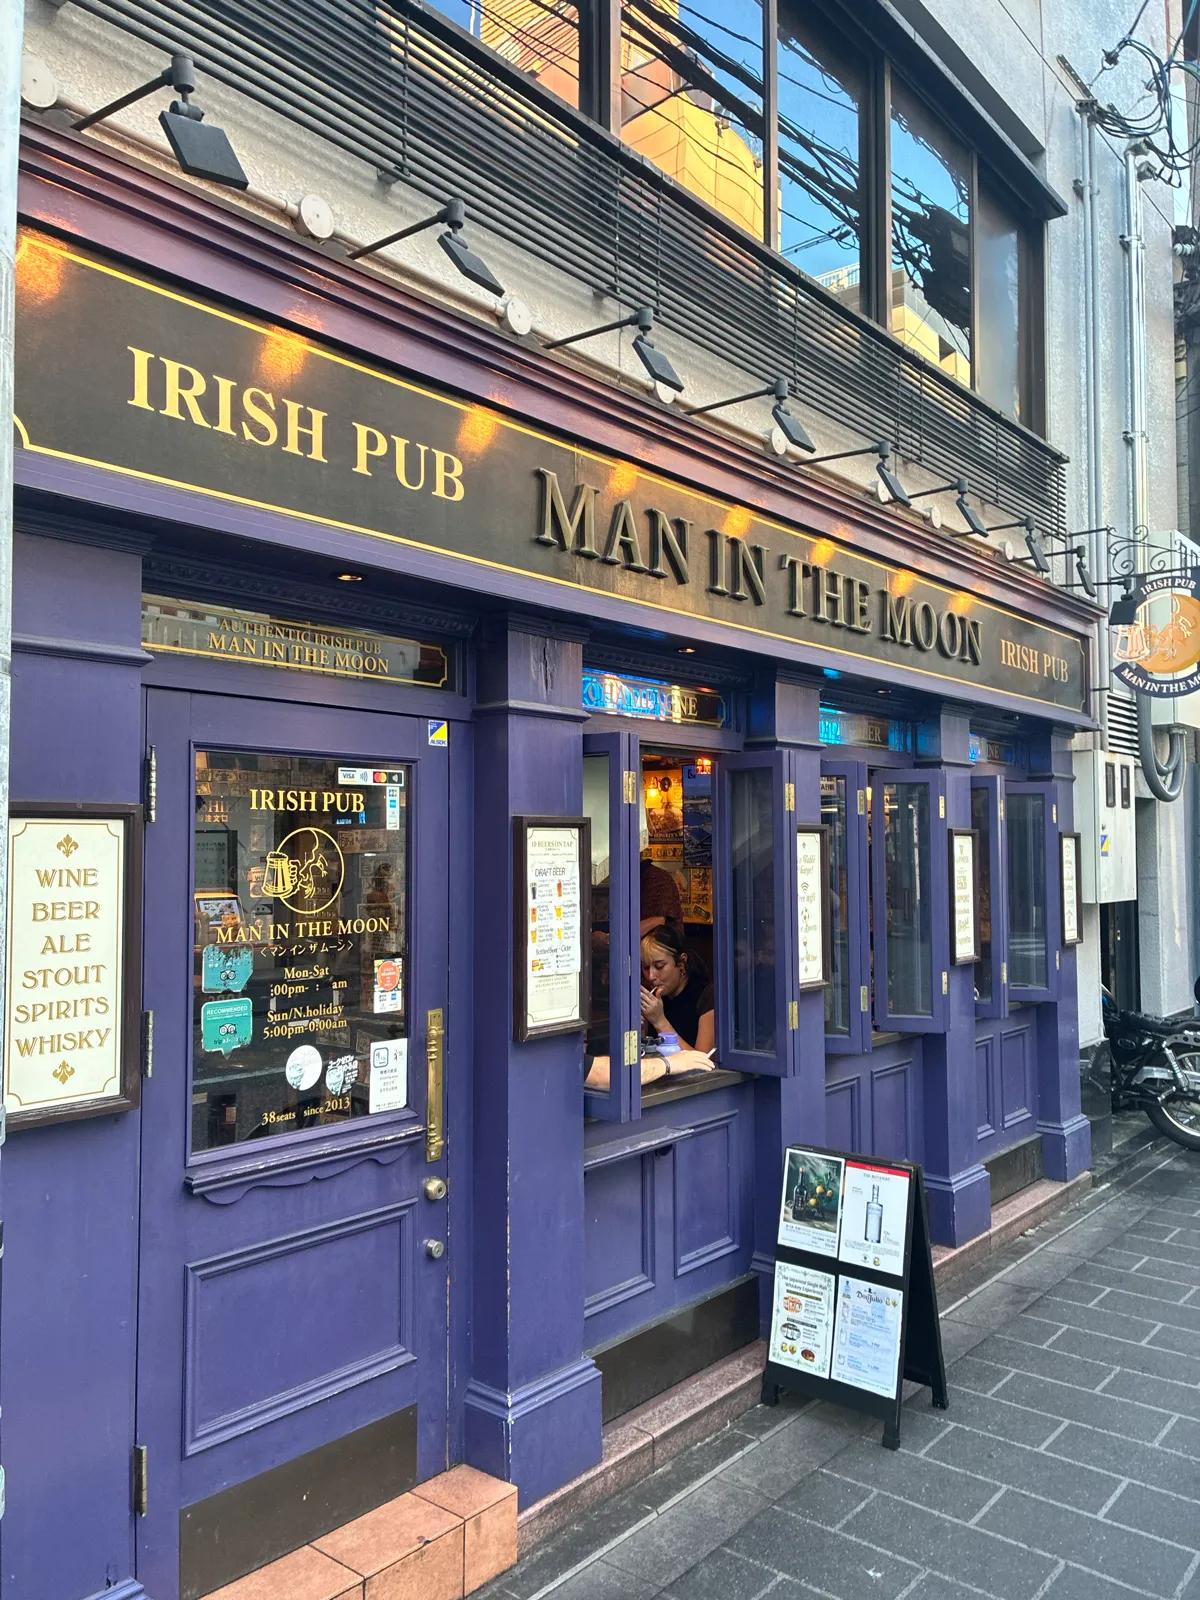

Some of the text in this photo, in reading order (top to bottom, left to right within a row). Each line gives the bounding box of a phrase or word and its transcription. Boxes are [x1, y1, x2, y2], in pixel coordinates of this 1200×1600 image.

[127, 345, 465, 503] IRISH PUB
[534, 466, 985, 667] MAN IN THE MOON
[1140, 577, 1197, 596] IRISH PUB
[221, 617, 381, 655] AUTHENTIC IRISH PUB
[208, 631, 389, 674] MAN IN THE MOON
[999, 636, 1070, 684] IRISH PUB
[1121, 668, 1145, 690] MAN
[1146, 682, 1160, 693] IN
[1161, 681, 1188, 693] THE
[250, 788, 365, 813] IRISH PUB
[35, 868, 99, 888] WINE
[552, 866, 566, 877] BEER
[32, 900, 101, 922] BEER
[216, 916, 390, 944] MAN IN THE MOON
[40, 933, 91, 955] ALE
[22, 964, 106, 990] STOUT
[284, 965, 329, 979] Mon-Sat
[14, 996, 110, 1024] SPIRITS
[14, 1028, 112, 1057] WHISKY
[303, 1106, 324, 1117] since
[324, 1097, 350, 1112] 2013
